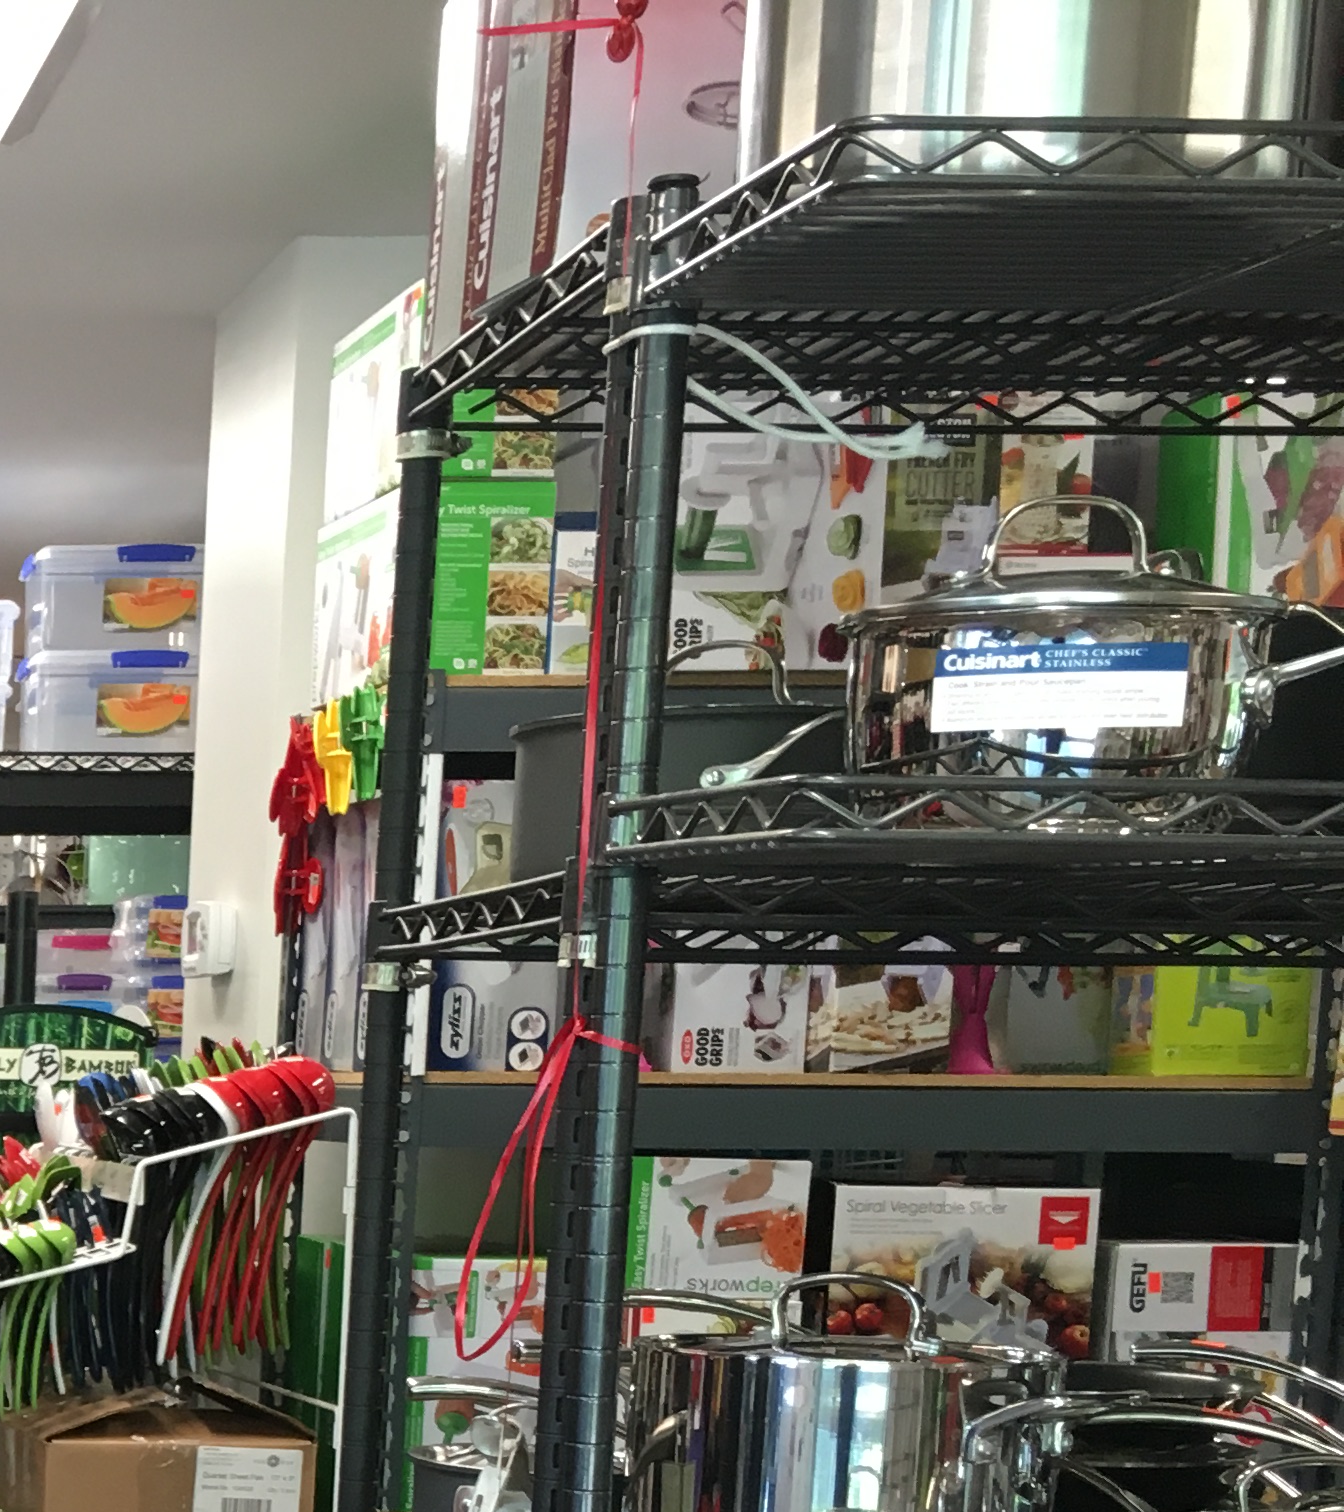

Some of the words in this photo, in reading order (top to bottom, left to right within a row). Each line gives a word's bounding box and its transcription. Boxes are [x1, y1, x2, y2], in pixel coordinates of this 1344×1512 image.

[474, 85, 503, 291] Cuisinart
[905, 471, 976, 498] CUTTER
[447, 503, 477, 515] Twist
[479, 503, 531, 516] Spiralizer
[943, 650, 1042, 672] Cuisinart
[1043, 658, 1112, 669] STAINLESS
[1044, 649, 1090, 659] CHEF'S
[1091, 647, 1144, 658] CLASSIC
[450, 991, 463, 1052] zyliss
[694, 1027, 711, 1067] GOOD
[709, 1027, 725, 1067] GRIPS
[636, 1180, 650, 1232] Spiralizer
[846, 1199, 886, 1216] Spiral
[890, 1199, 965, 1218] Vegetable
[968, 1199, 1009, 1216] Slicer
[633, 1234, 649, 1261] Twist
[686, 1276, 781, 1293] repworks
[1129, 1262, 1149, 1314] GEFU
